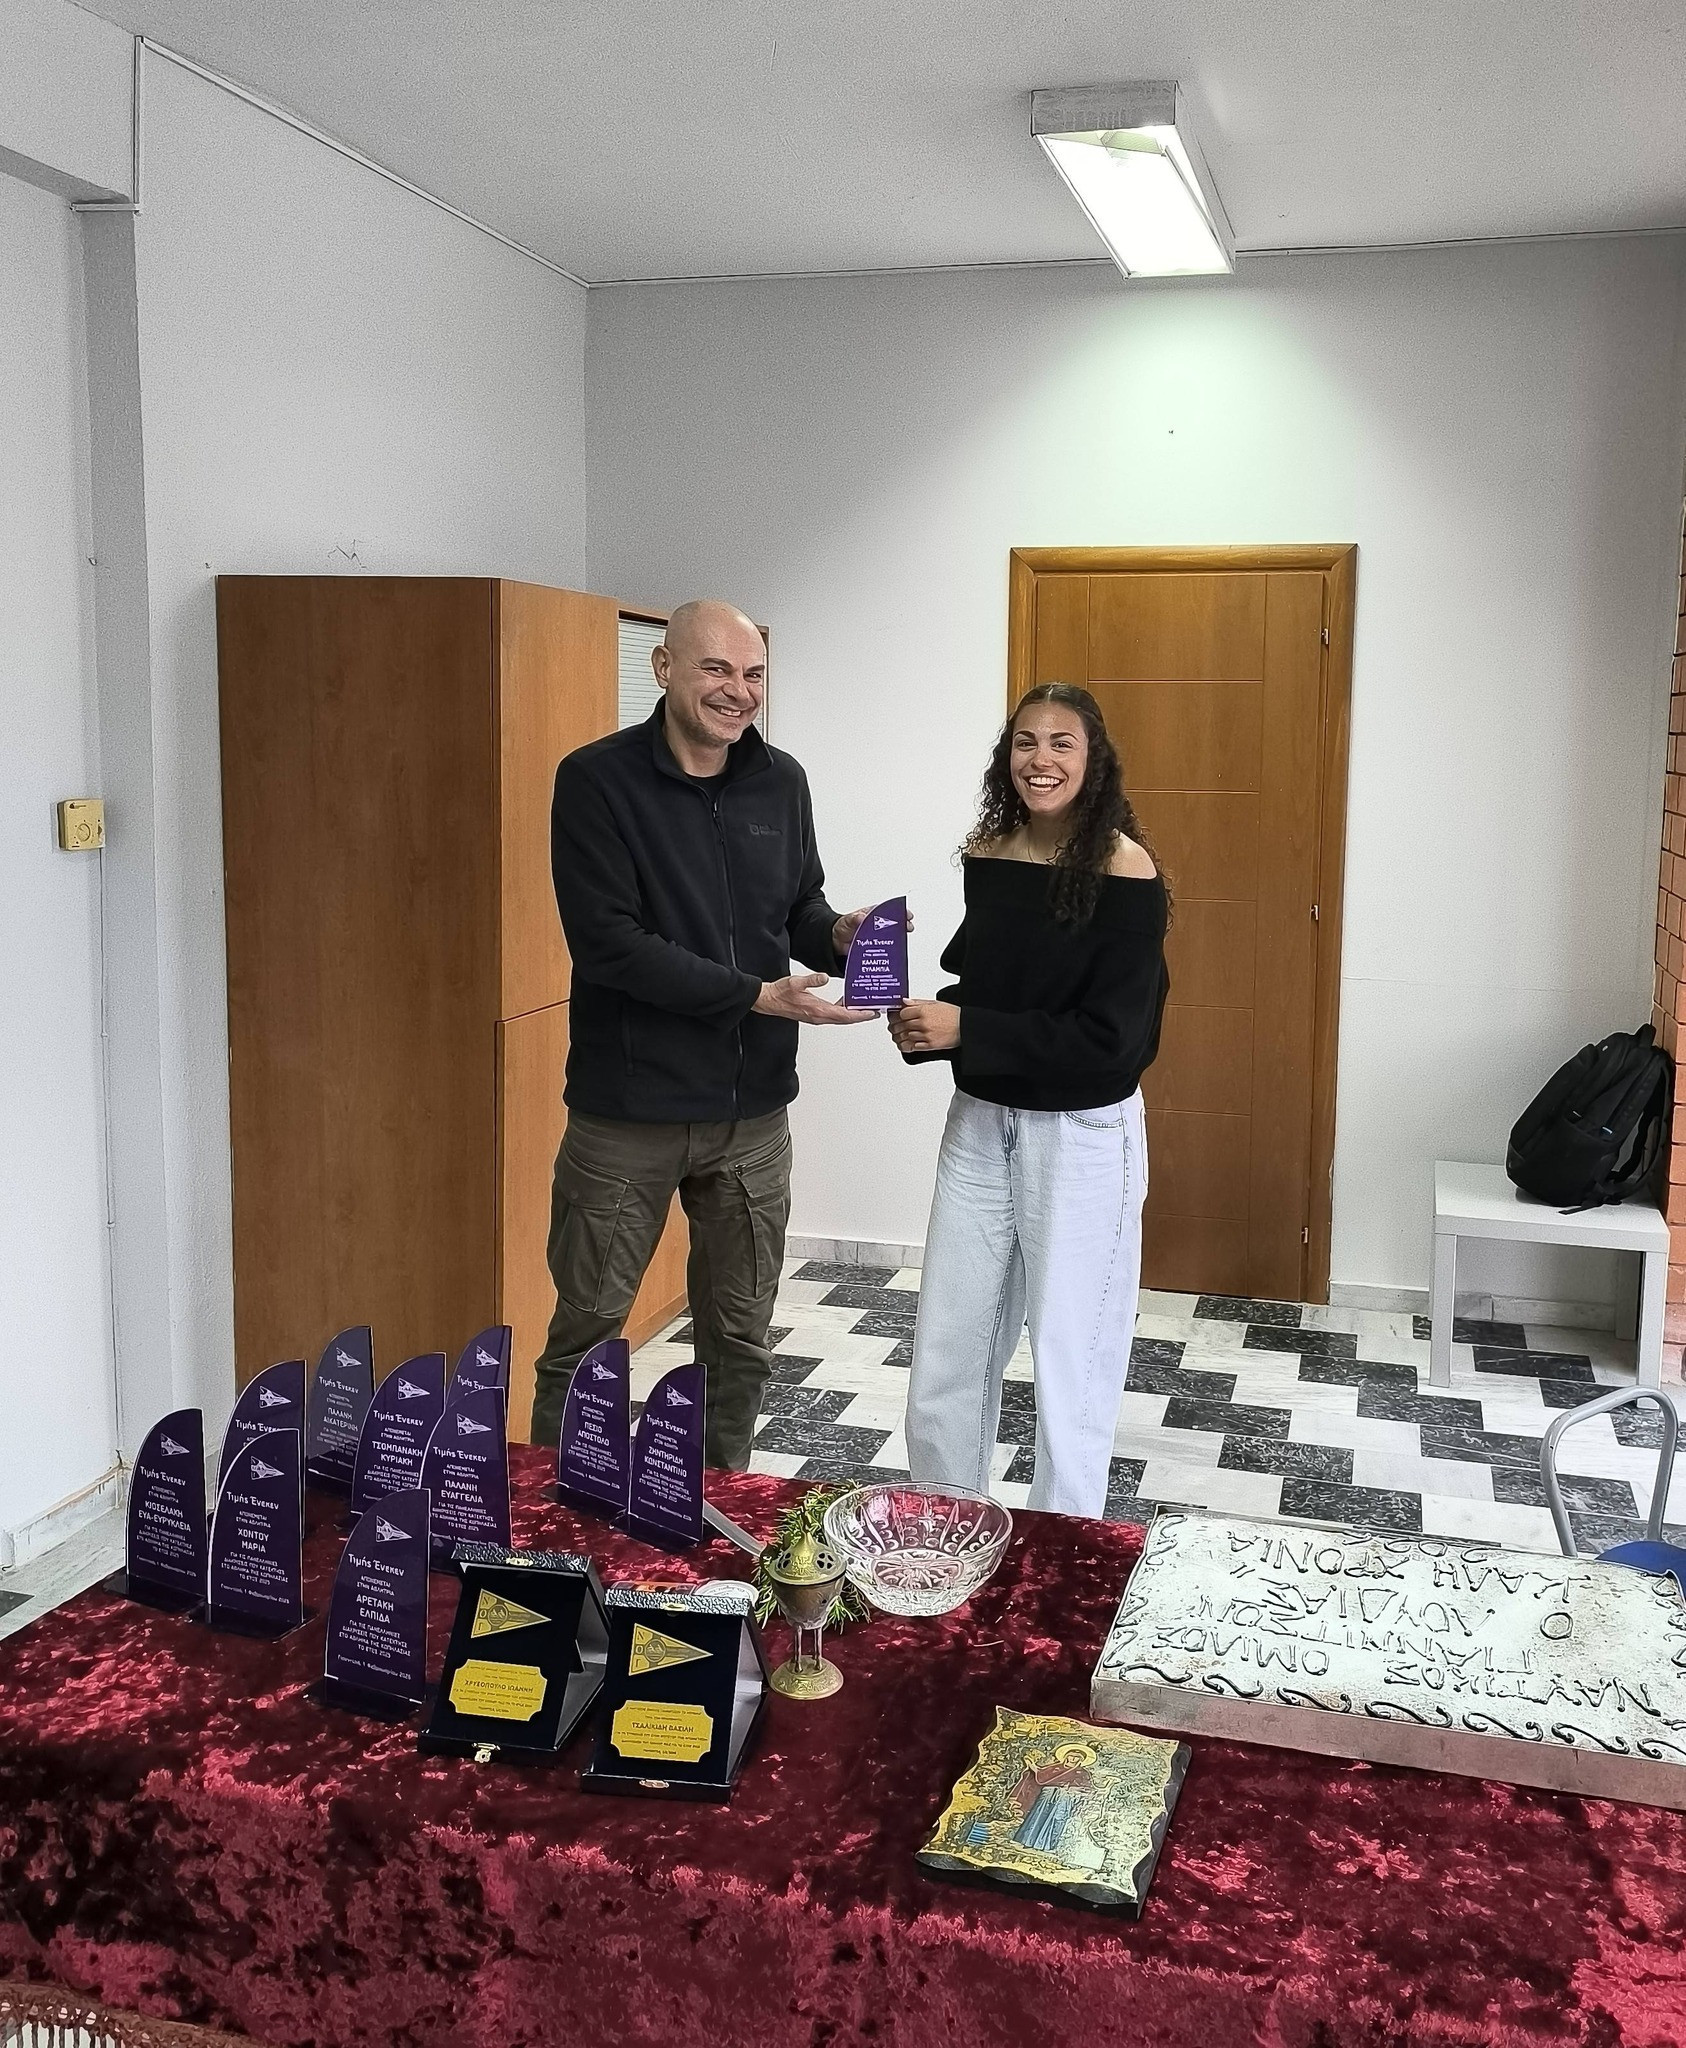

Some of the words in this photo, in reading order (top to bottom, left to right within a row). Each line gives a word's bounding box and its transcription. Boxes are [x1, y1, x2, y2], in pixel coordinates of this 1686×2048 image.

[373, 1411, 394, 1422] Τιμής
[396, 1415, 424, 1427] Ένεκεν
[578, 1429, 610, 1447] ΑΠΟΣΤΟΛΟ
[372, 1441, 423, 1458] ΤΣΟΜΠΑΝΑΚΗ
[433, 1447, 456, 1458] Τιμής
[457, 1450, 487, 1463] Ένεκεν
[380, 1453, 413, 1466] ΚΥΡΙΑΚΗ
[644, 1455, 687, 1478] ΚΩΝΣΤΑΝΤΙΝΟ
[140, 1466, 159, 1479] Τιμής
[160, 1472, 186, 1487] Ένεκεν
[445, 1480, 478, 1492] ΠΑΛΑΝΗ
[227, 1491, 248, 1504] Τιμής
[250, 1496, 279, 1511] Ένεκεν
[441, 1490, 483, 1504] ΕΥΑΓΓΕΛΙΑ
[145, 1500, 183, 1519] ΚΙΟΣΕΛΑΚΗ
[138, 1509, 191, 1533] ΕΥΑ-ΕΥΡΥΚΛΕΙΑ
[238, 1527, 269, 1543] ΧΟΝΤΟΥ
[241, 1540, 266, 1553] ΜΑΡΙΑ
[1228, 1532, 1409, 1579] ΧΡΟΝΙΑ
[348, 1554, 372, 1568] Τιμής
[374, 1560, 404, 1577] Ένεκεν
[1434, 1562, 1591, 1604] ΚΑΛΗ
[356, 1593, 394, 1612] ΑΡΕΤΑΚΗ
[360, 1607, 390, 1624] ΕΛΠΙΔΑ
[1540, 1612, 1573, 1640] Ο
[1152, 1626, 1329, 1676] ΟΜΙΛΟΣ
[1384, 1663, 1660, 1717] ΝΑΥΤΙΚΟΣ
[632, 1722, 668, 1731] ΤΣΑΛΙΚΙΔΗ
[668, 1725, 694, 1733] ΒΑΣΙΛΗ
